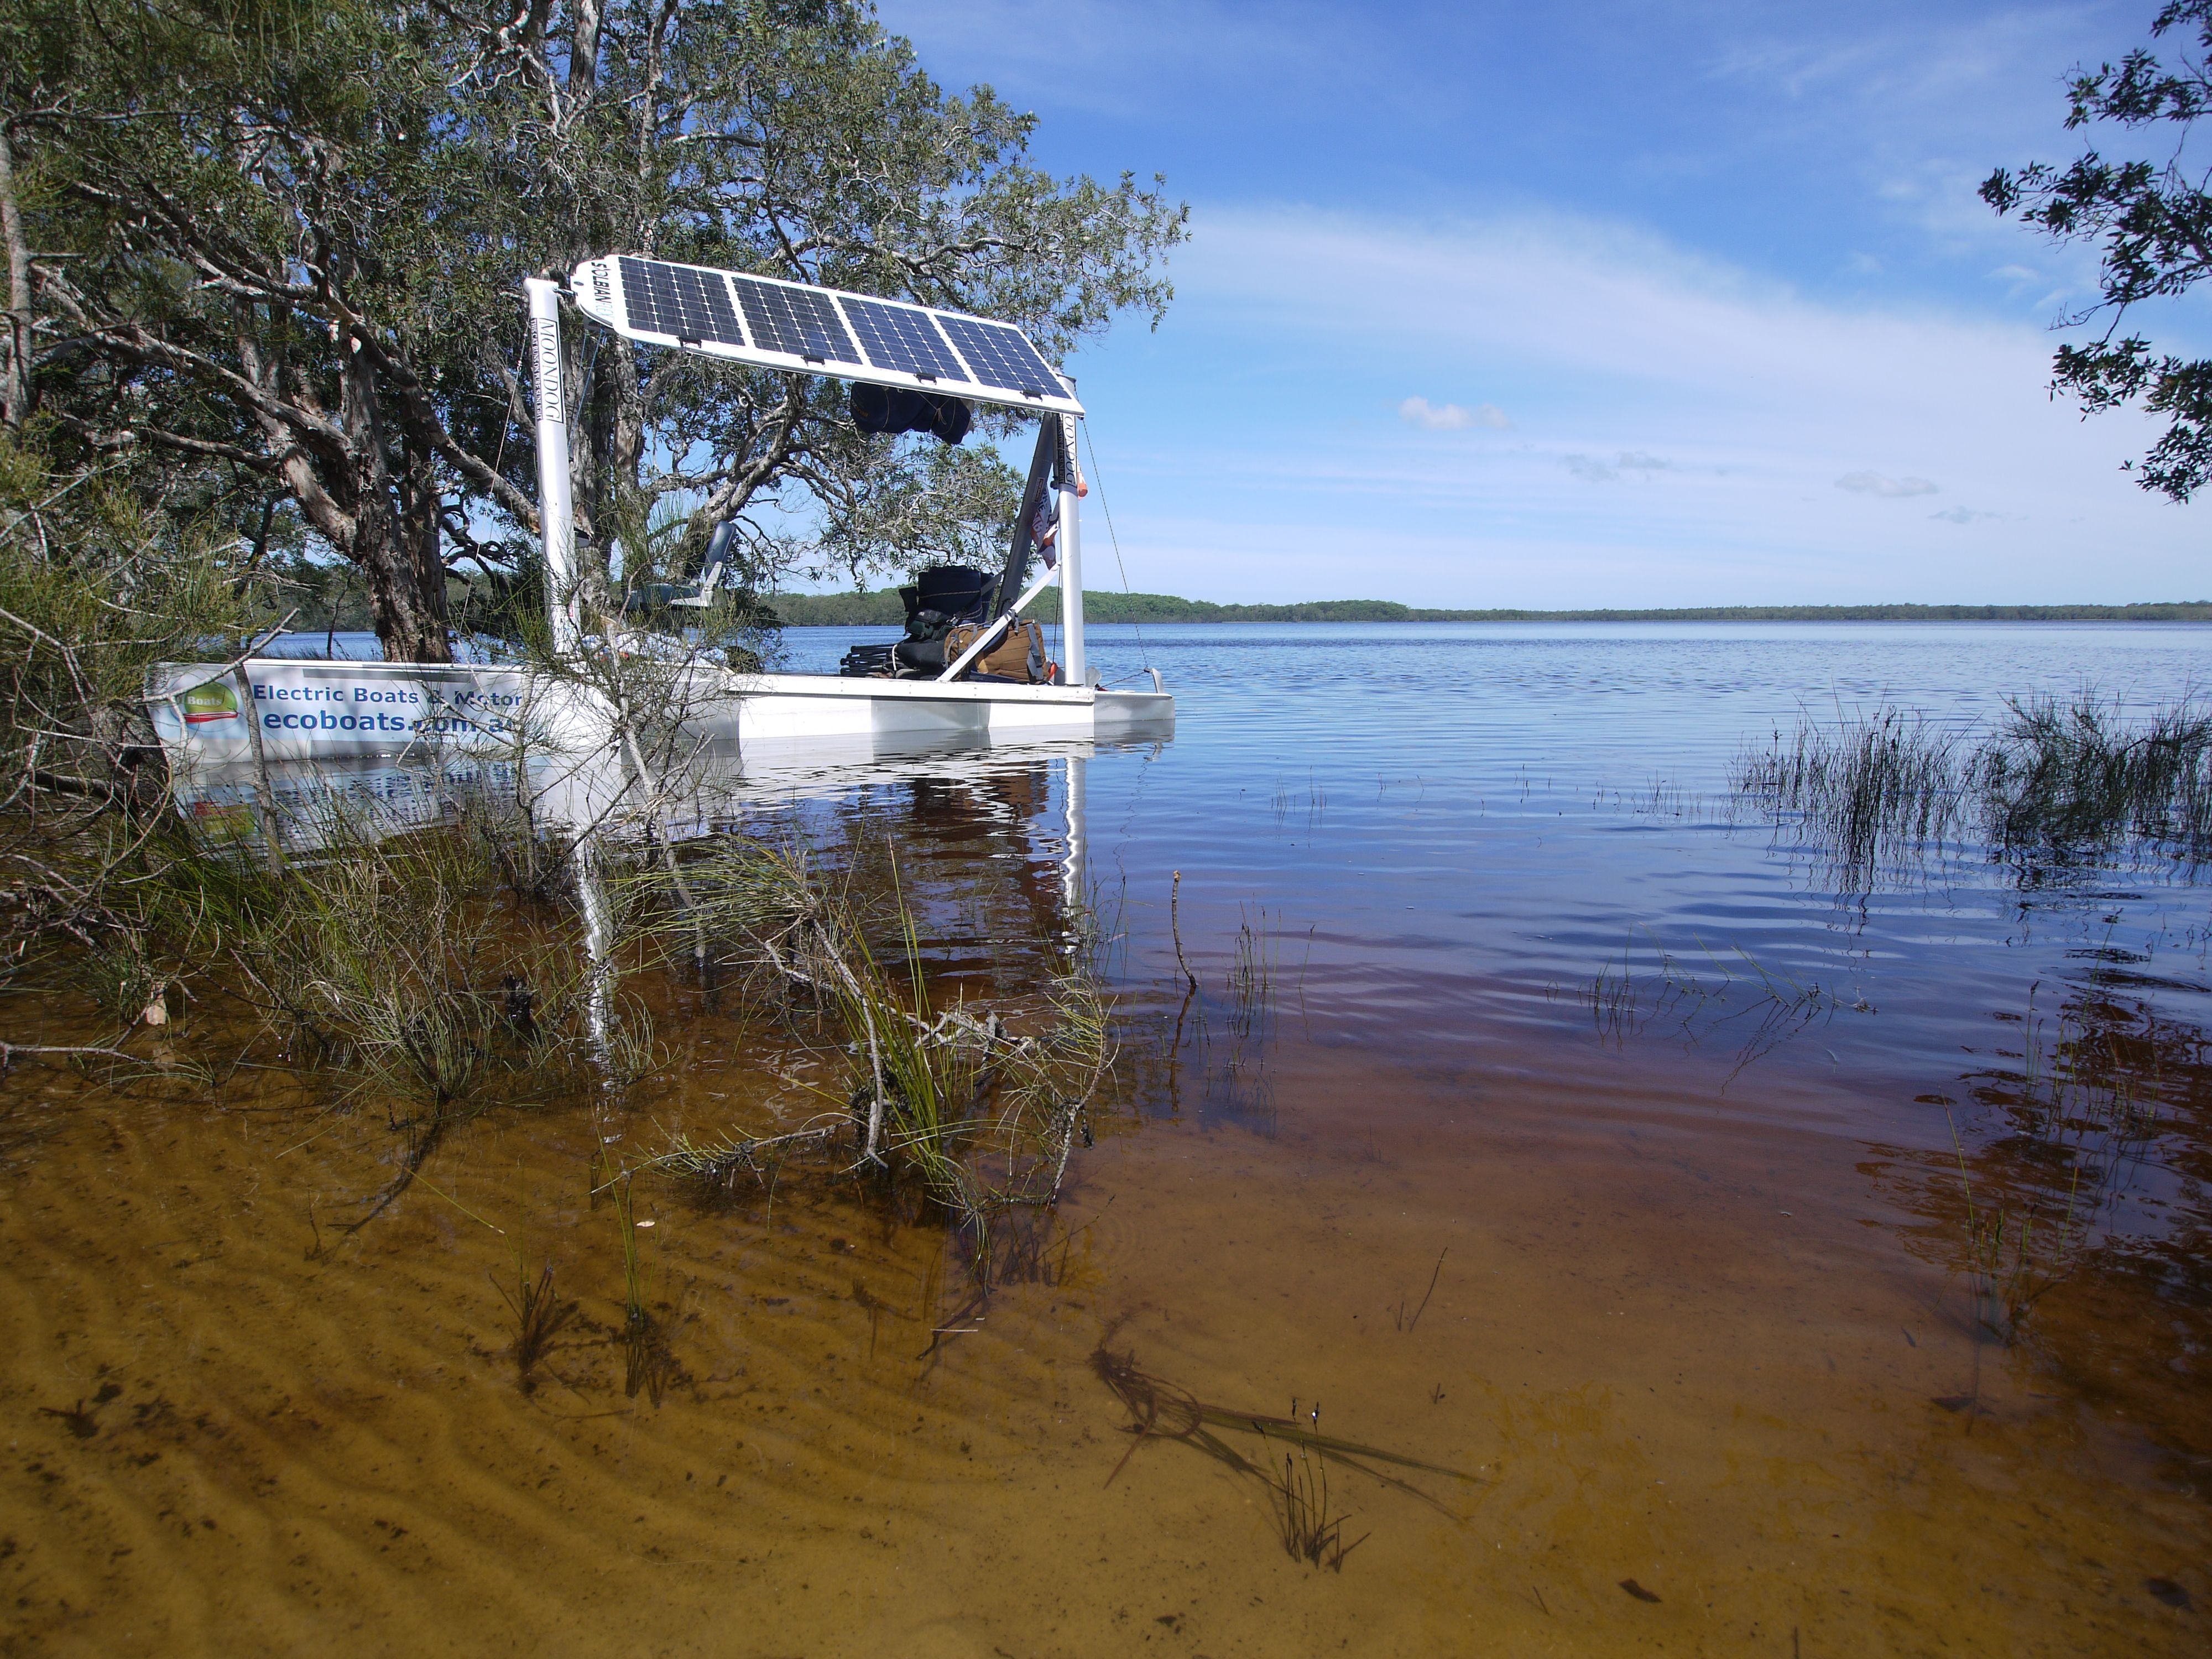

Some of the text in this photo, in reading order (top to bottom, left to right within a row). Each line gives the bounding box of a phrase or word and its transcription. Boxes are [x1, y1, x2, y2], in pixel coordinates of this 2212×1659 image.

[534, 363, 540, 372] ON
[539, 321, 560, 419] MOONDOG
[1064, 415, 1076, 484] OONDOG
[186, 696, 223, 706] Boats
[253, 685, 345, 702] Electric
[354, 687, 419, 704] Boats
[264, 710, 513, 733] ecoboats.coma
